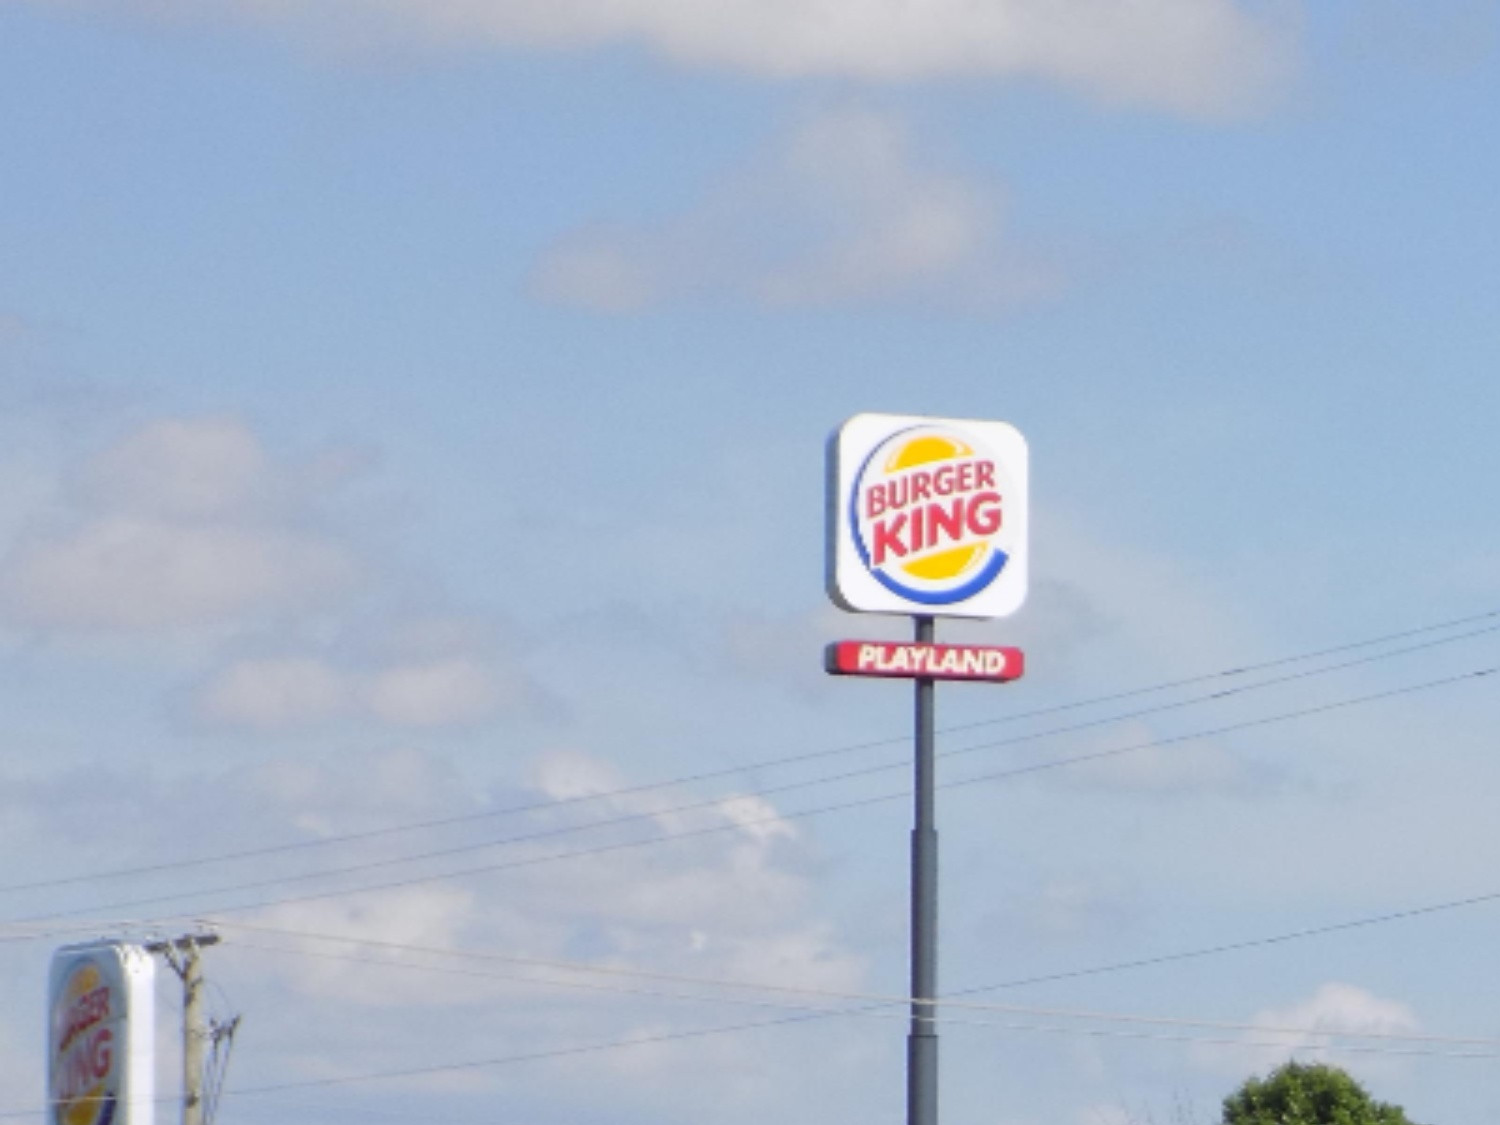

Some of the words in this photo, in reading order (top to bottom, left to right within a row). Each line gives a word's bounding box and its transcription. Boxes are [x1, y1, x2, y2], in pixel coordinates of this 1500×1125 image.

[866, 460, 995, 519] BURGER
[873, 491, 1002, 567] KING
[857, 644, 1007, 673] PLAYLAND
